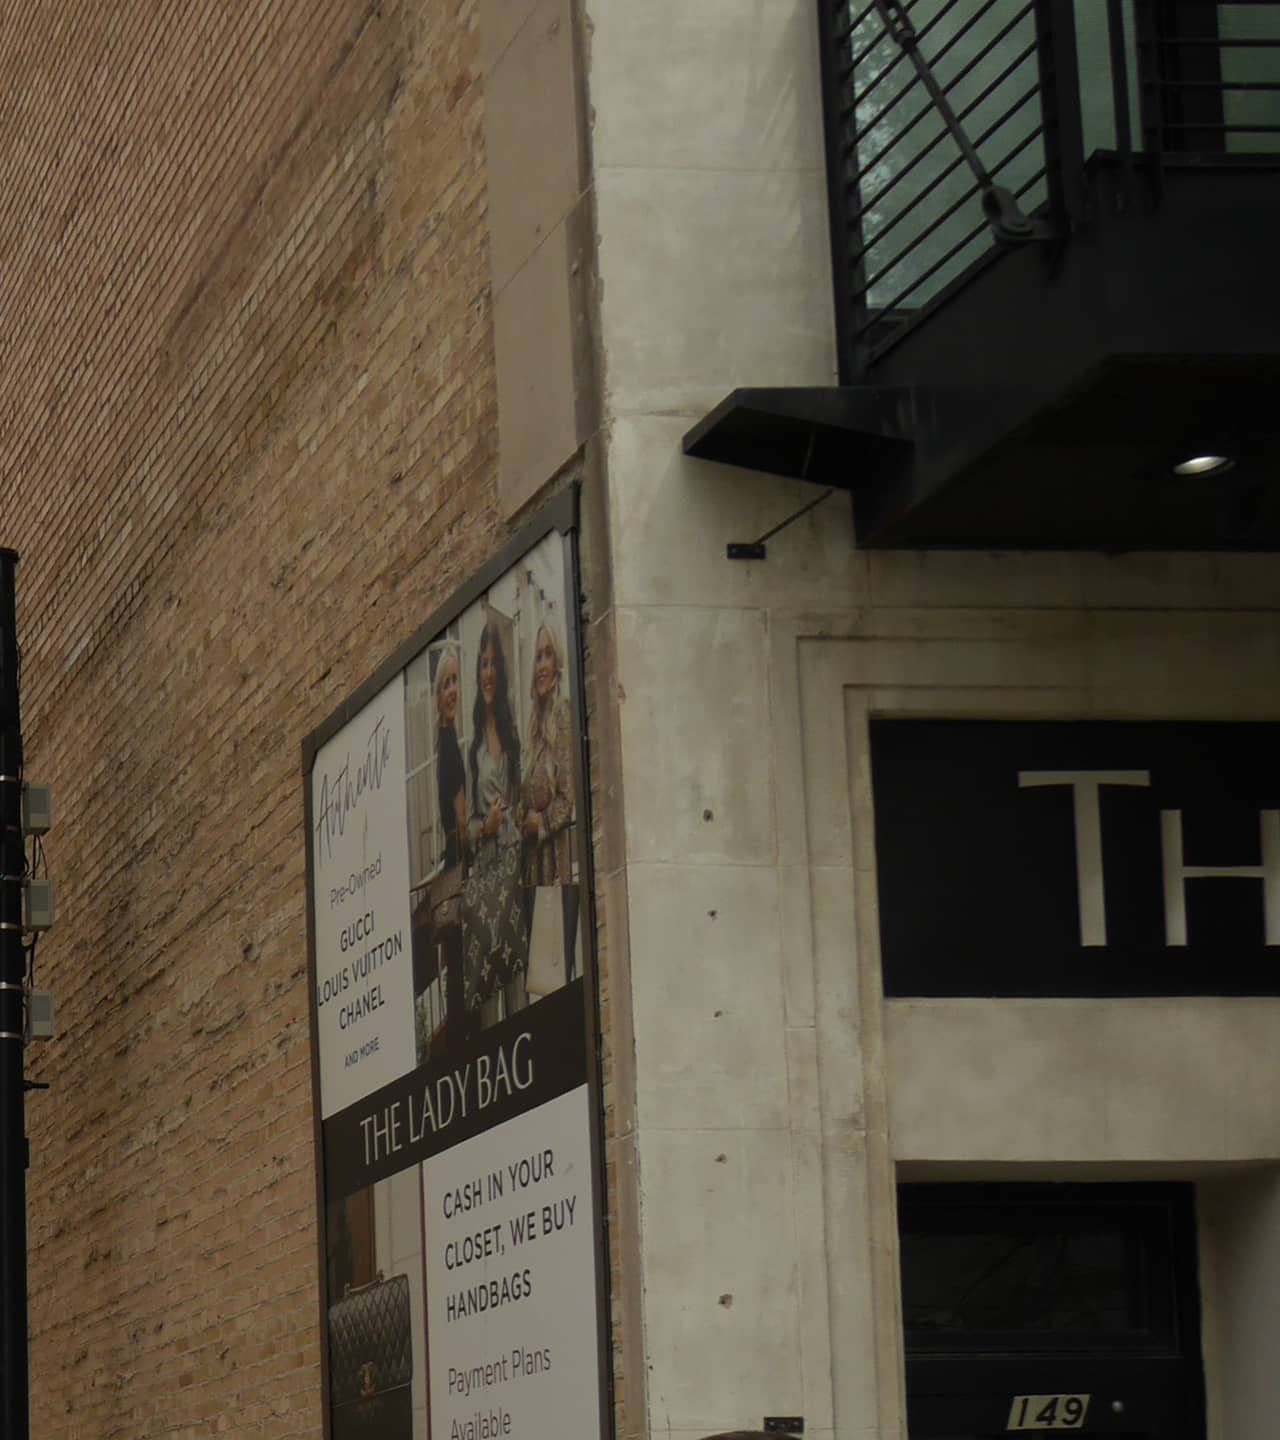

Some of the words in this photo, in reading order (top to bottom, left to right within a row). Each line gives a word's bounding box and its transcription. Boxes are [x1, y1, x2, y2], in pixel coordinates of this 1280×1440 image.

[330, 852, 382, 910] Pre-Owned
[340, 910, 375, 953] GUCCI
[317, 967, 349, 1007] LOUIS
[351, 930, 403, 983] VUITTON
[339, 984, 385, 1030] CHANEL
[344, 1050, 359, 1069] AND
[359, 1036, 381, 1062] MORE
[360, 1102, 402, 1166] THE
[408, 1063, 470, 1143] LADY
[476, 1032, 533, 1110] BAG
[443, 1178, 482, 1219] CASH
[487, 1170, 504, 1202] IN
[508, 1149, 555, 1192] YOUR
[445, 1224, 505, 1270] CLOSET,
[509, 1211, 537, 1247] WE
[542, 1194, 577, 1236] BUY
[446, 1268, 532, 1322] HANDBAGS
[448, 1353, 508, 1397] Payment
[512, 1346, 551, 1379] Plans
[1016, 1397, 1084, 1428] 149
